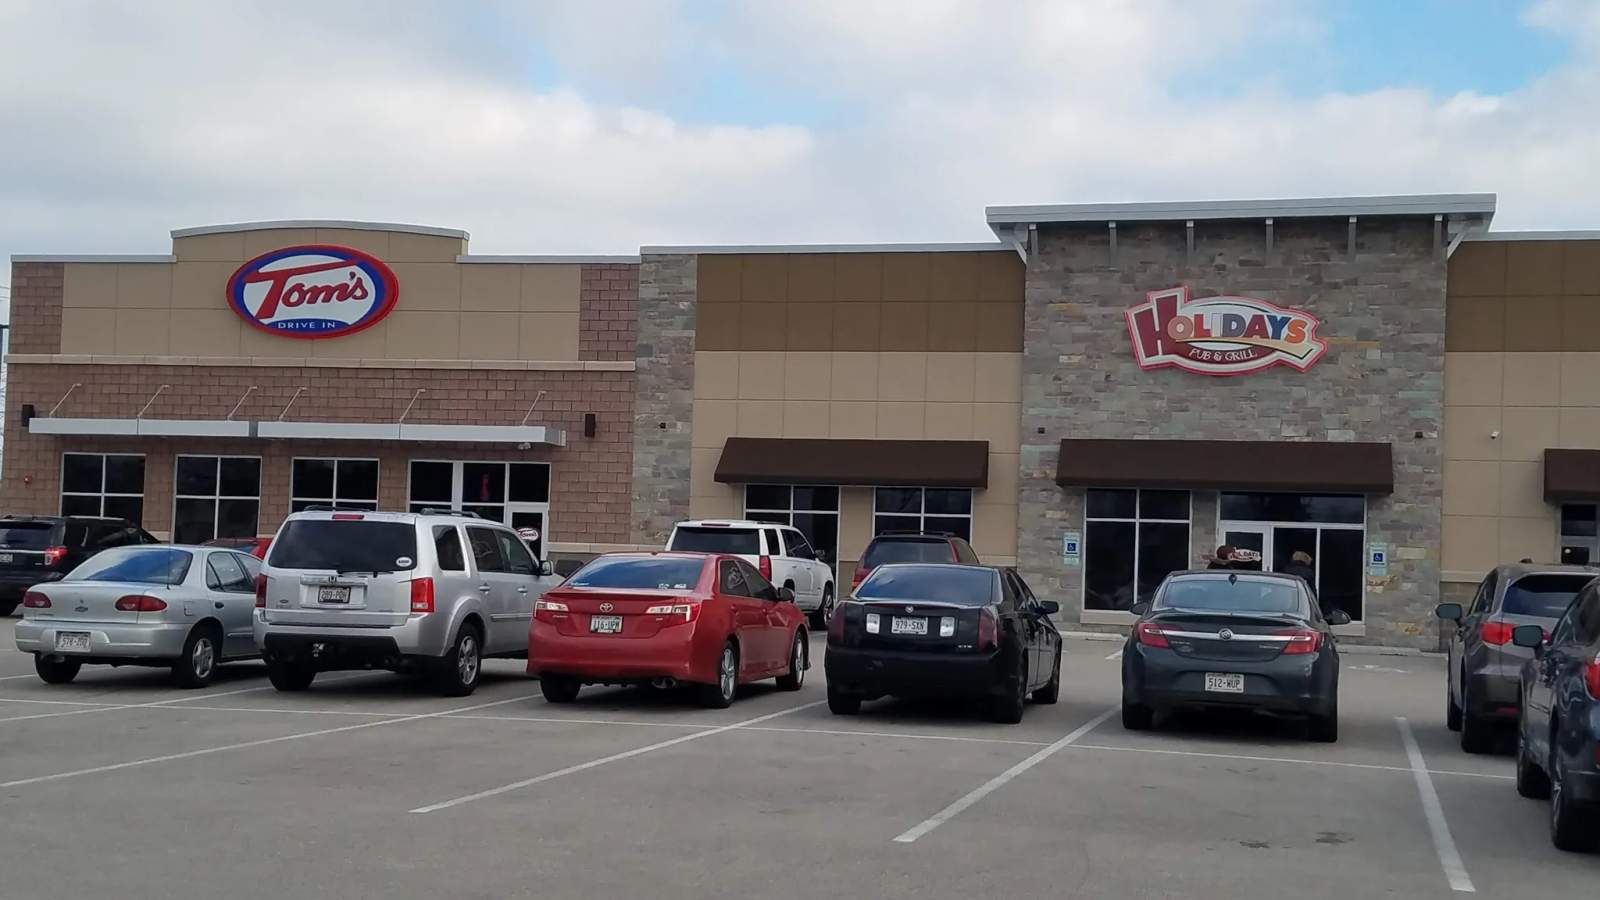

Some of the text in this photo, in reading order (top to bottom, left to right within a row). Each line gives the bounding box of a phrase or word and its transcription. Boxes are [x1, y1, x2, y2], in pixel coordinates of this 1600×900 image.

[244, 259, 369, 320] Tom's
[278, 321, 336, 329] DRIVE IN
[1134, 294, 1308, 359] HOLIDAYS
[1188, 348, 1257, 362] PUB & GRILL
[1208, 677, 1241, 690] 512-WUP
